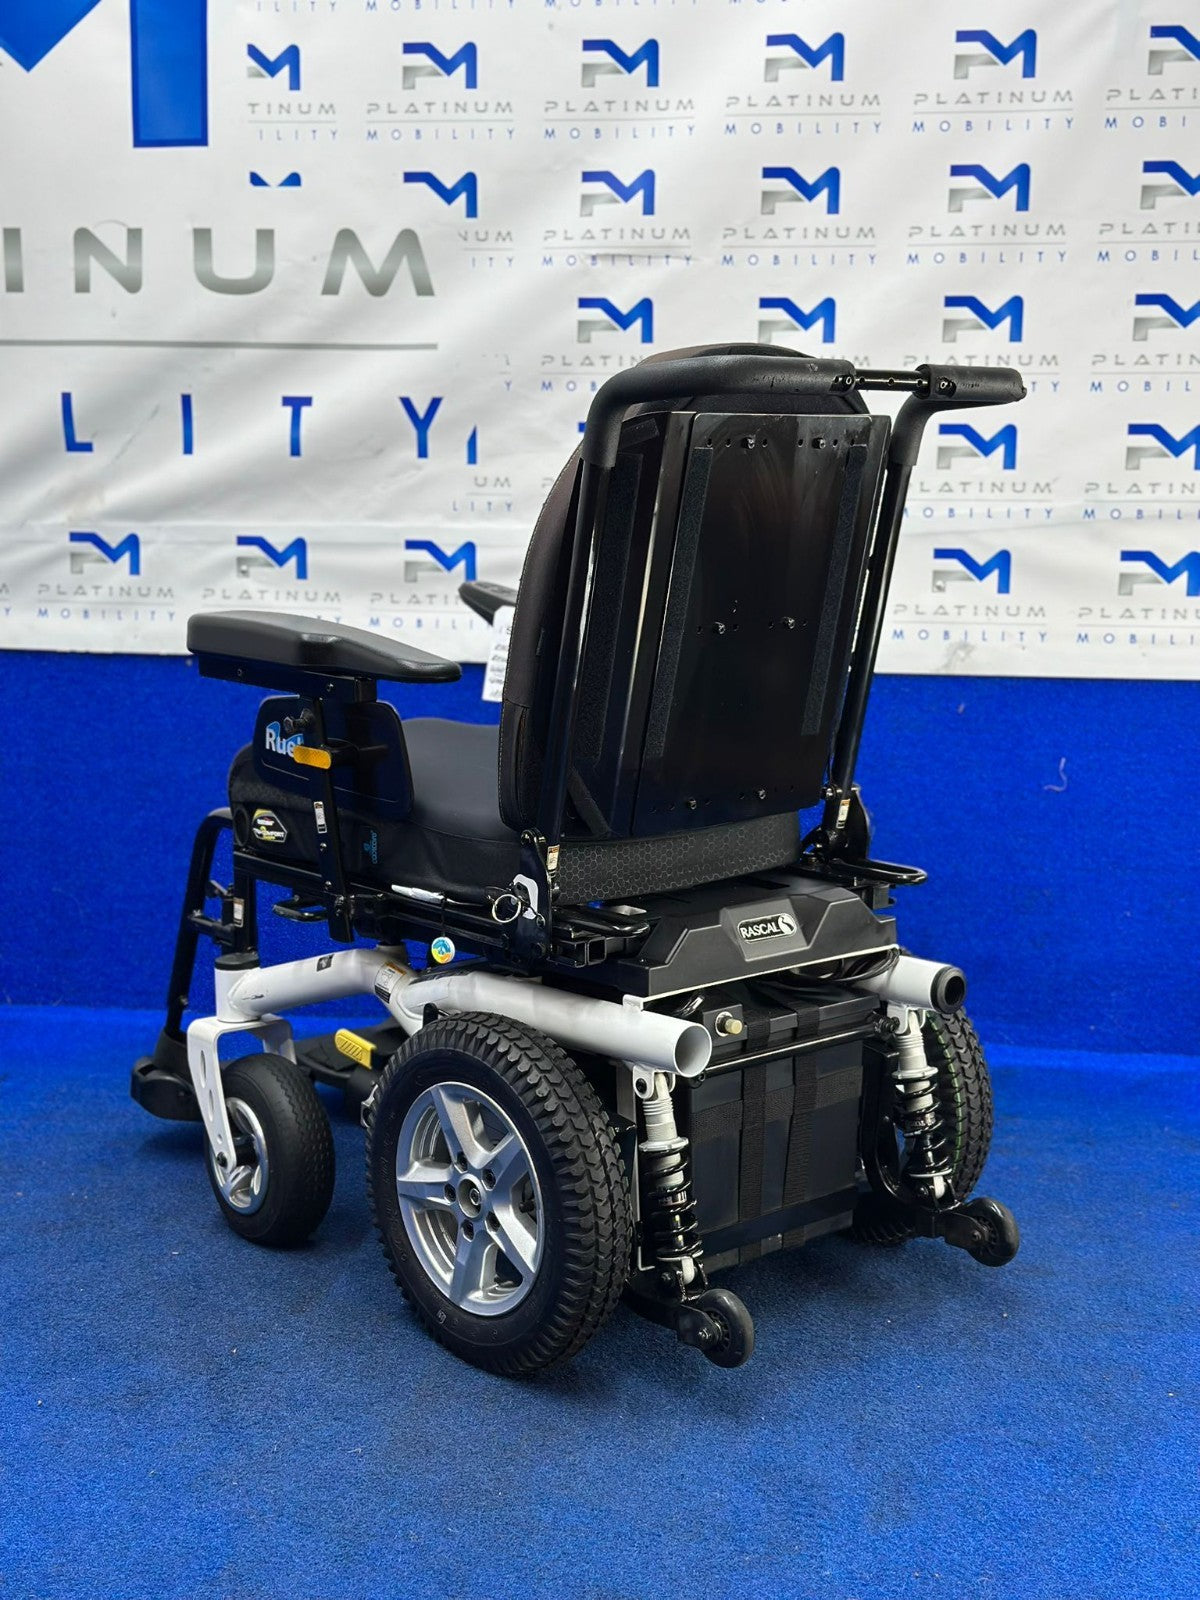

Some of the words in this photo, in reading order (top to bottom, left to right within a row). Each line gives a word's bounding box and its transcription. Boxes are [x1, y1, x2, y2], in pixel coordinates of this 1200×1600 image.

[725, 94, 881, 109] PLATINUM
[913, 89, 1074, 105] PLATINUM
[366, 101, 514, 115] PLATINUM
[543, 99, 695, 113] PLATINUM
[543, 125, 696, 139] MOBILITY
[725, 122, 882, 136] MOBILITY
[912, 117, 1075, 133] MOBILITY
[366, 128, 516, 141] MOBILITY
[543, 227, 691, 241] PLATINUM
[722, 227, 876, 241] PLATINUM
[907, 223, 1067, 238] PLATINUM
[542, 253, 692, 267] MOBILITY
[722, 253, 877, 267] MOBILITY
[906, 252, 1067, 264] MOBILITY
[918, 480, 1053, 494] LATINUM
[38, 583, 175, 598] PLATINUM
[202, 587, 342, 602] PLATINUM
[37, 607, 175, 621] MOBILITY
[892, 603, 1047, 618] PLATINUM
[892, 629, 1048, 643] MOBILITY
[739, 921, 781, 939] RASCAL
